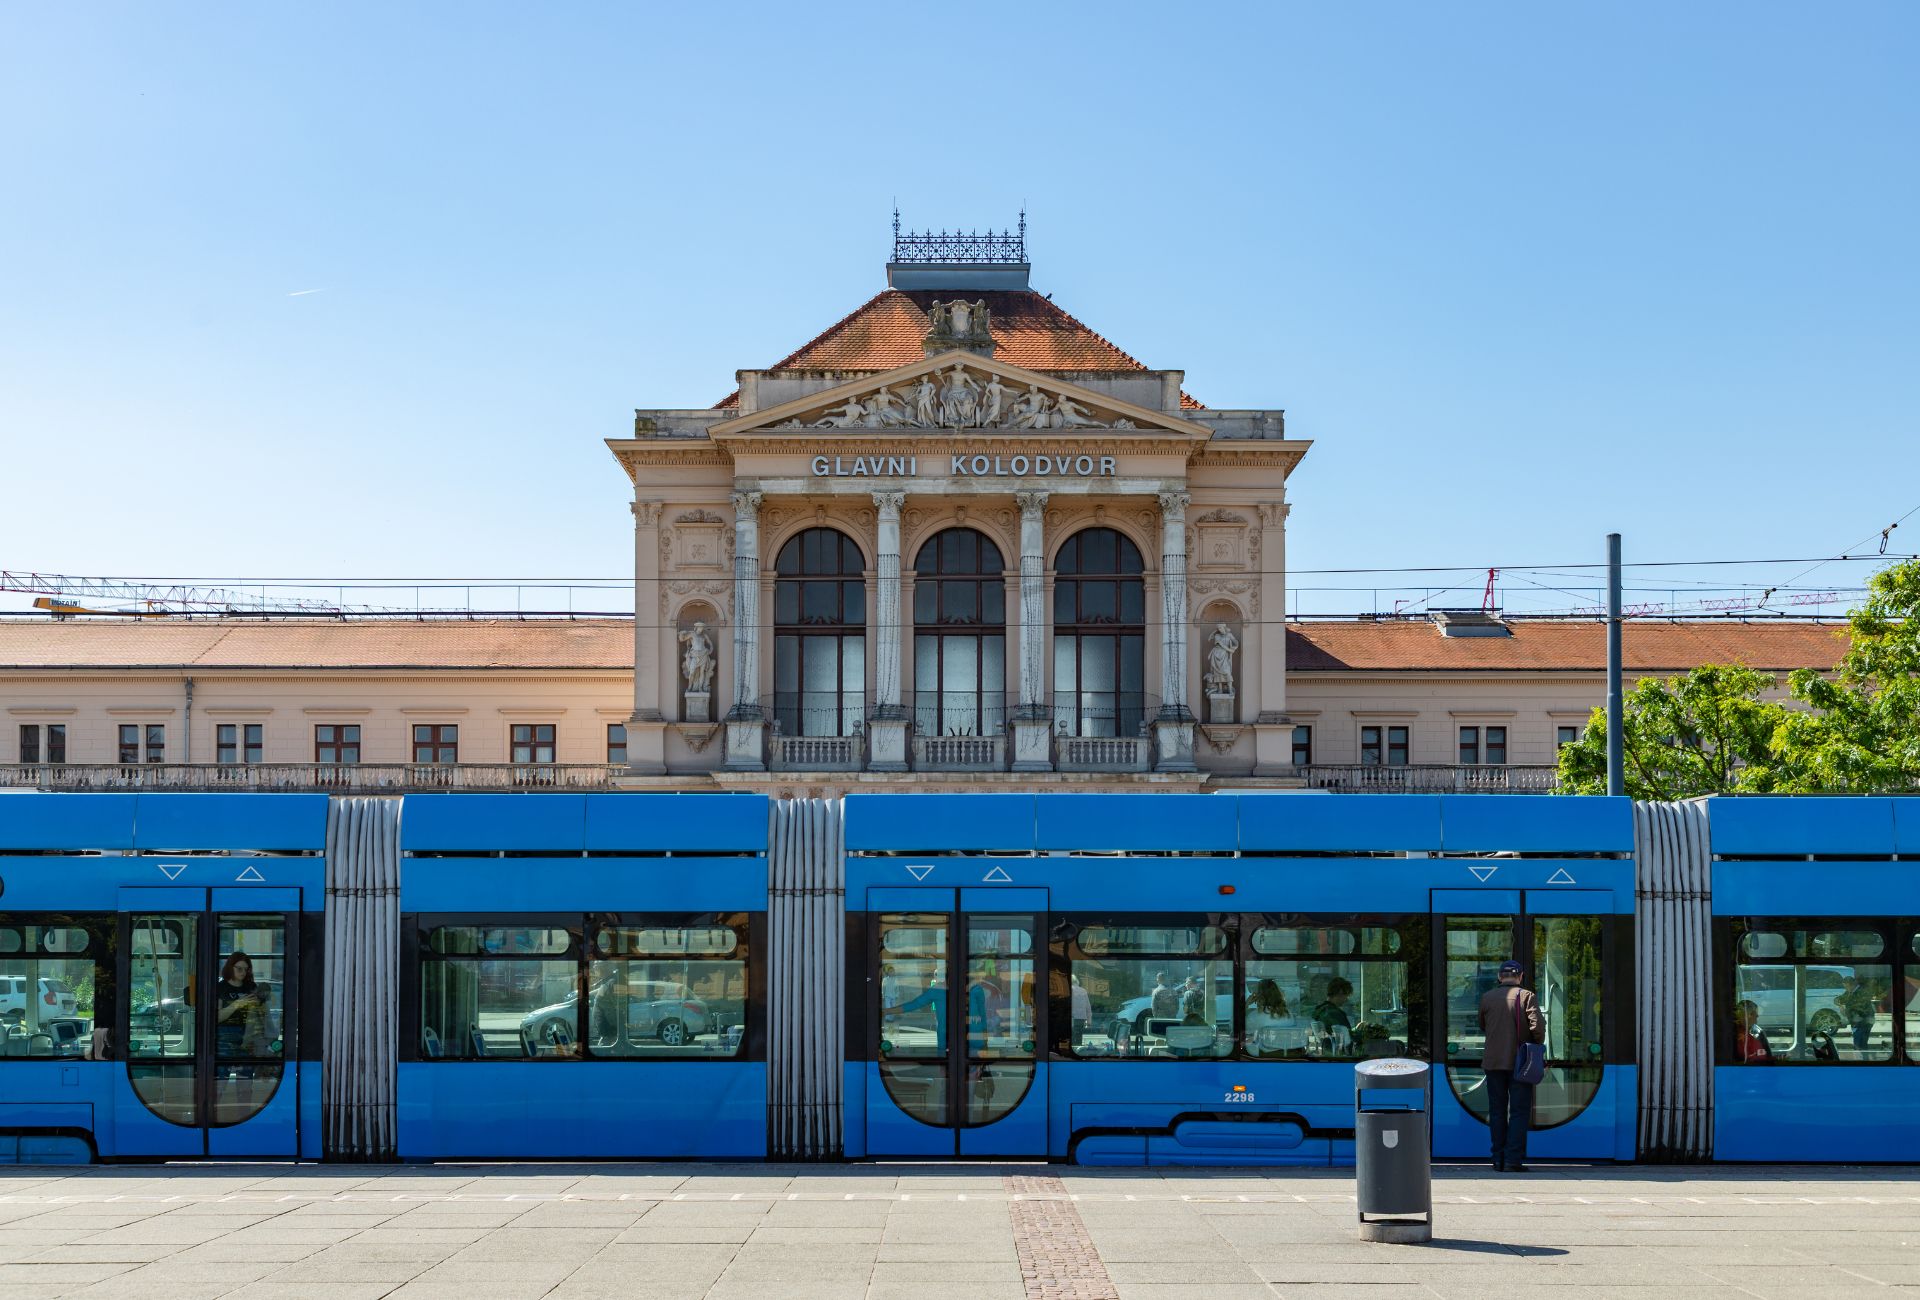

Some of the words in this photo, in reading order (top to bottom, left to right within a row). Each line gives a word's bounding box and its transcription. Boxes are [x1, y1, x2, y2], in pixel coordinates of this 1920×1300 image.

[811, 455, 916, 476] GLAVNI
[951, 455, 1116, 476] KOLODVOR
[1224, 1092, 1255, 1102] 2298
